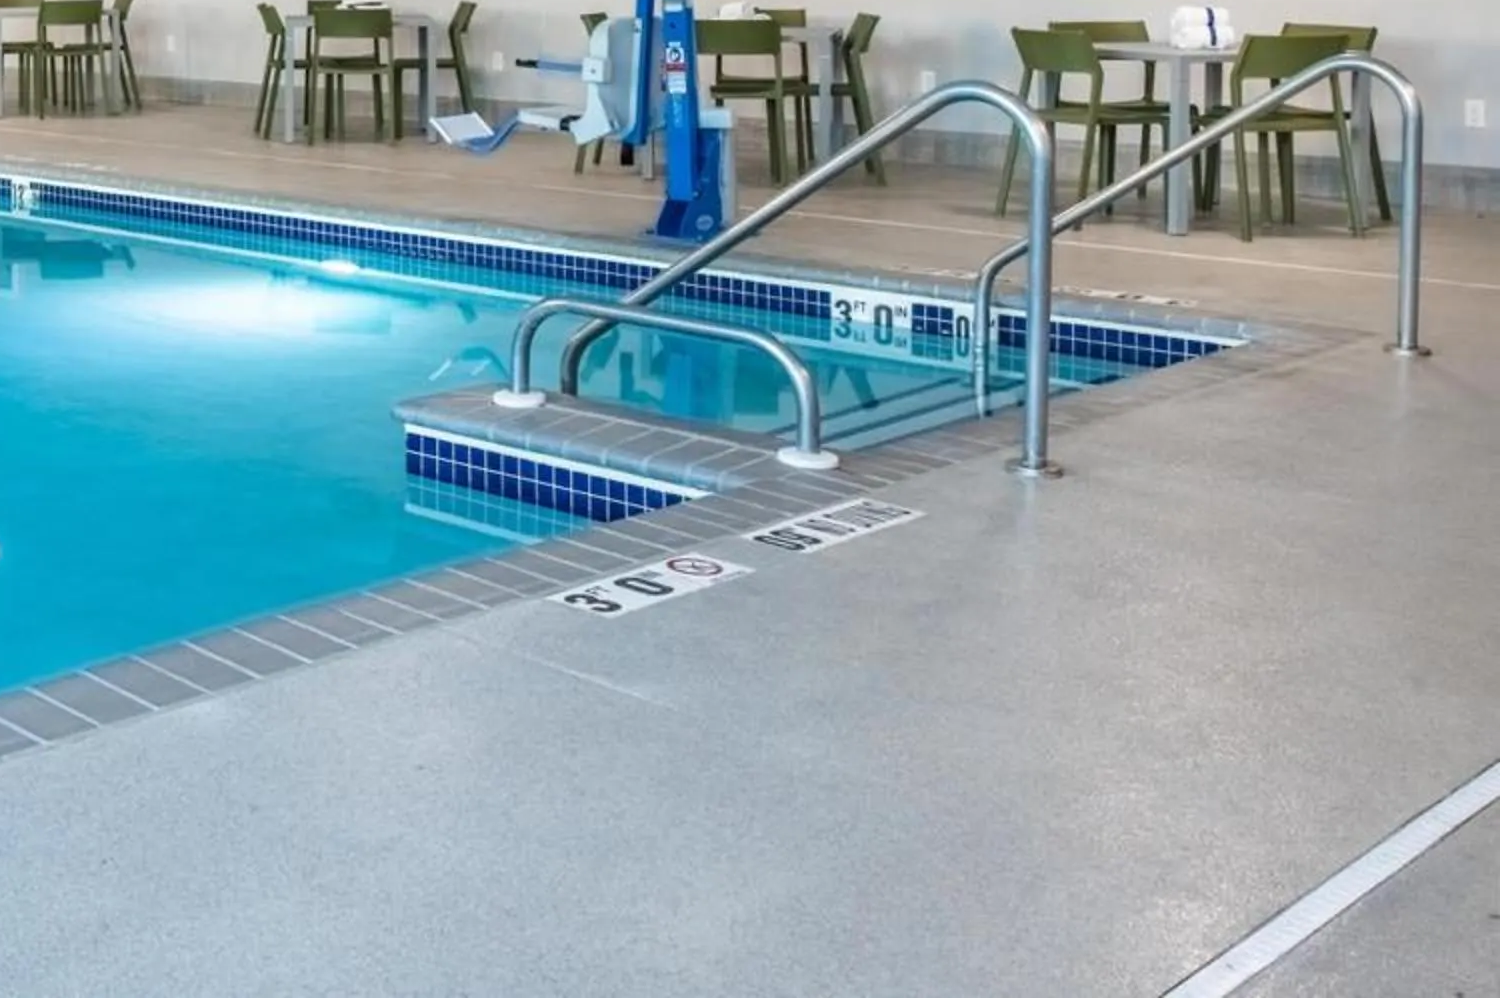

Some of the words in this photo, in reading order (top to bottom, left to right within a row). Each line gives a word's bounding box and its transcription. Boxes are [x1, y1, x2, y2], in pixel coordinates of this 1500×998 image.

[874, 305, 892, 344] 0
[564, 593, 622, 613] 3
[614, 577, 674, 596] 0
